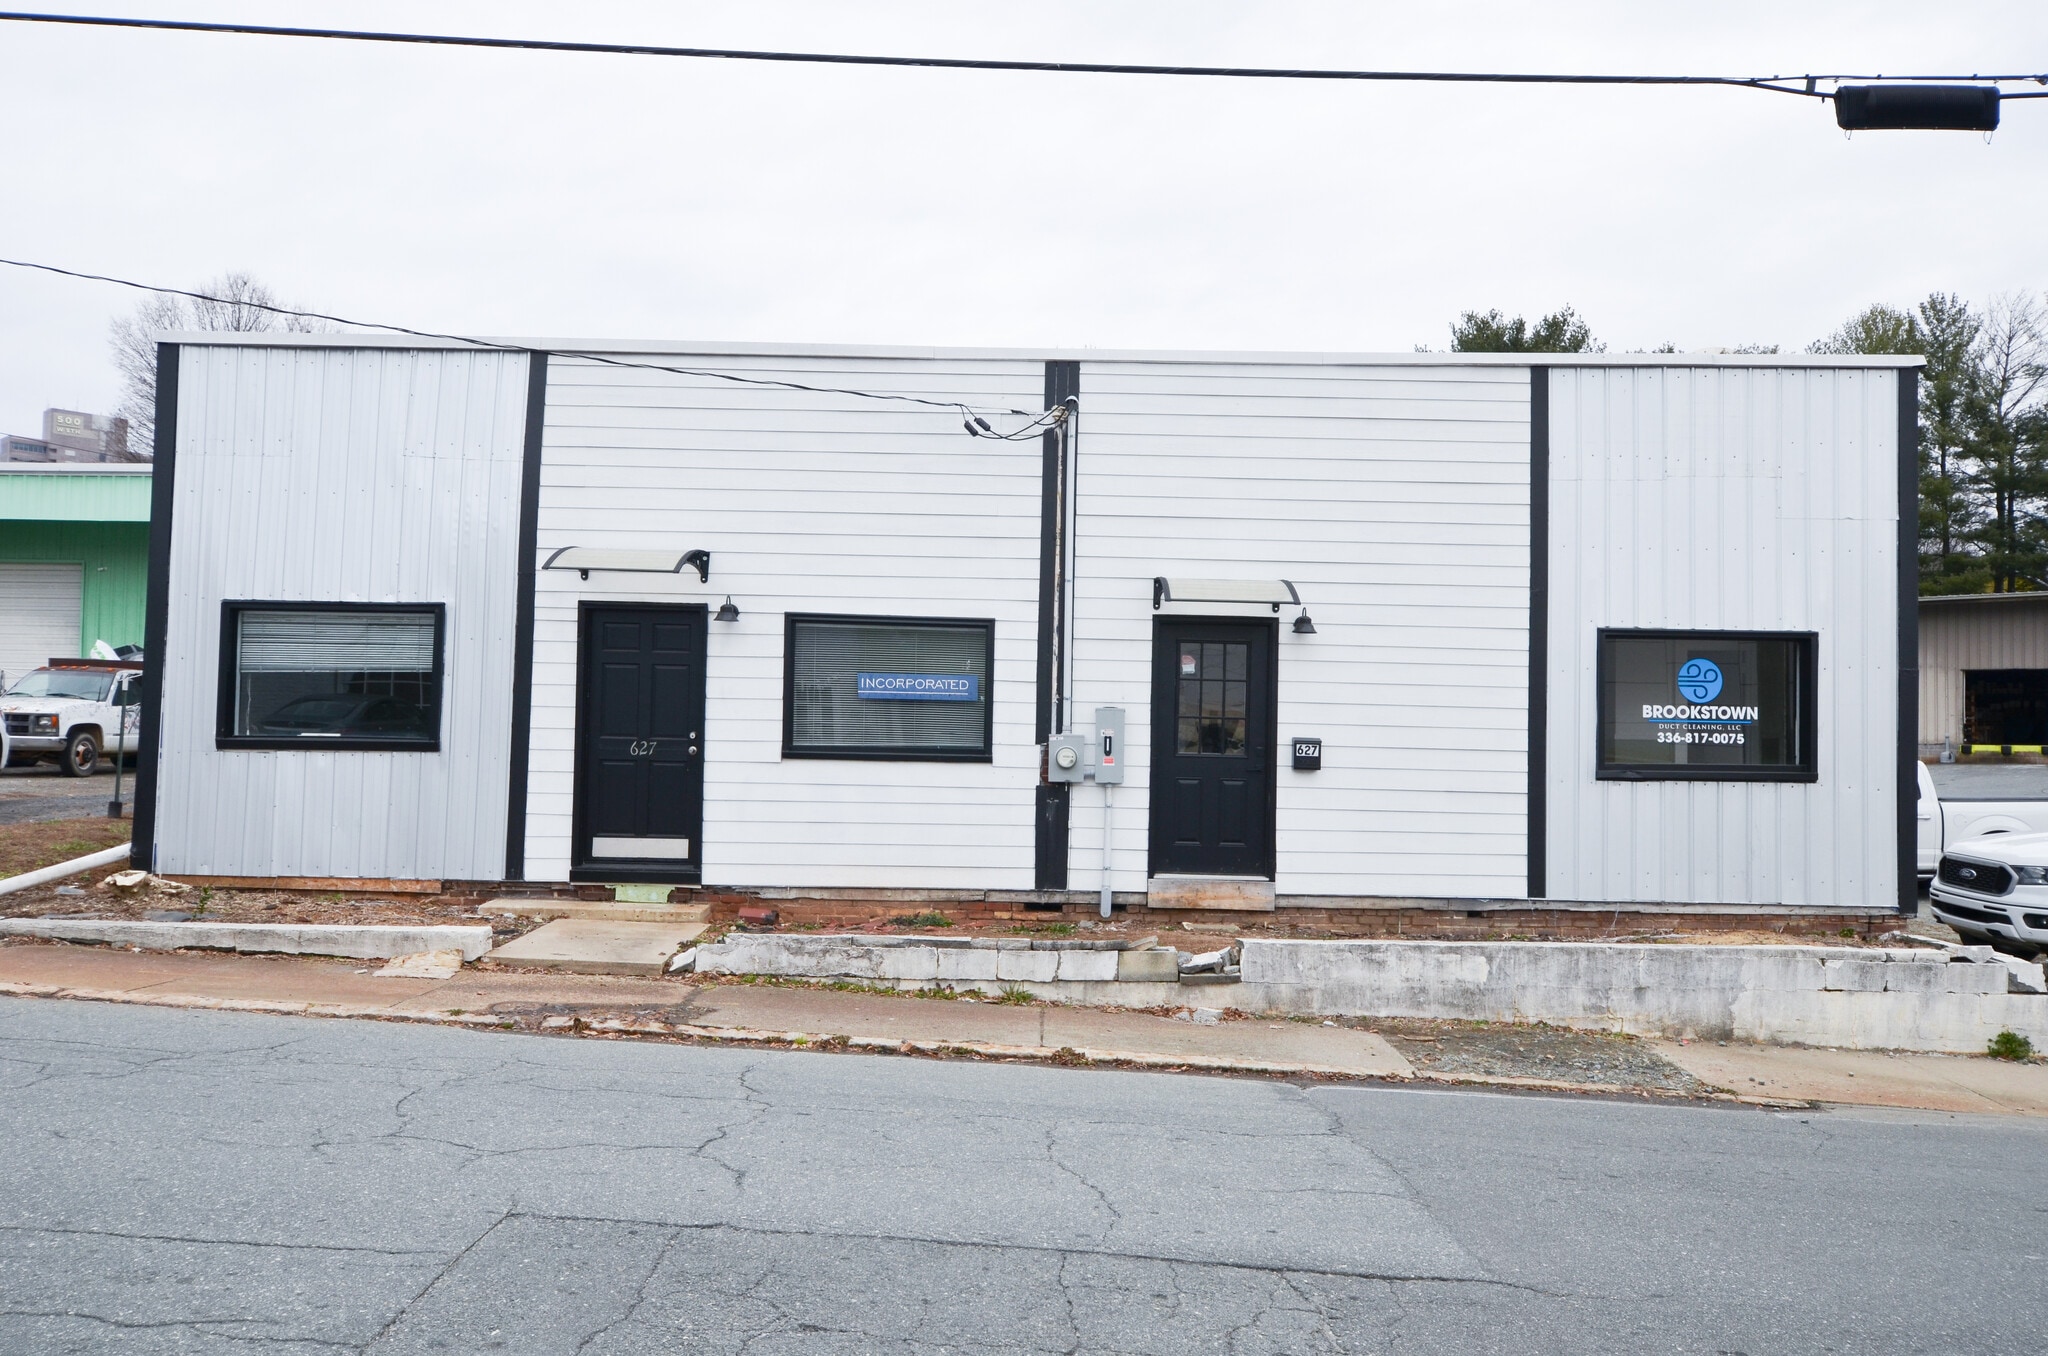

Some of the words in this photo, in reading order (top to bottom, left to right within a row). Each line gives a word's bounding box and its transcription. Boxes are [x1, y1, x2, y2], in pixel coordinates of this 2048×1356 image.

[861, 677, 969, 690] INCORPORATED
[1642, 704, 1759, 720] BROOKSTOWN
[1657, 732, 1745, 744] 336-817-0075
[630, 740, 657, 756] 627
[1297, 744, 1318, 756] 627
